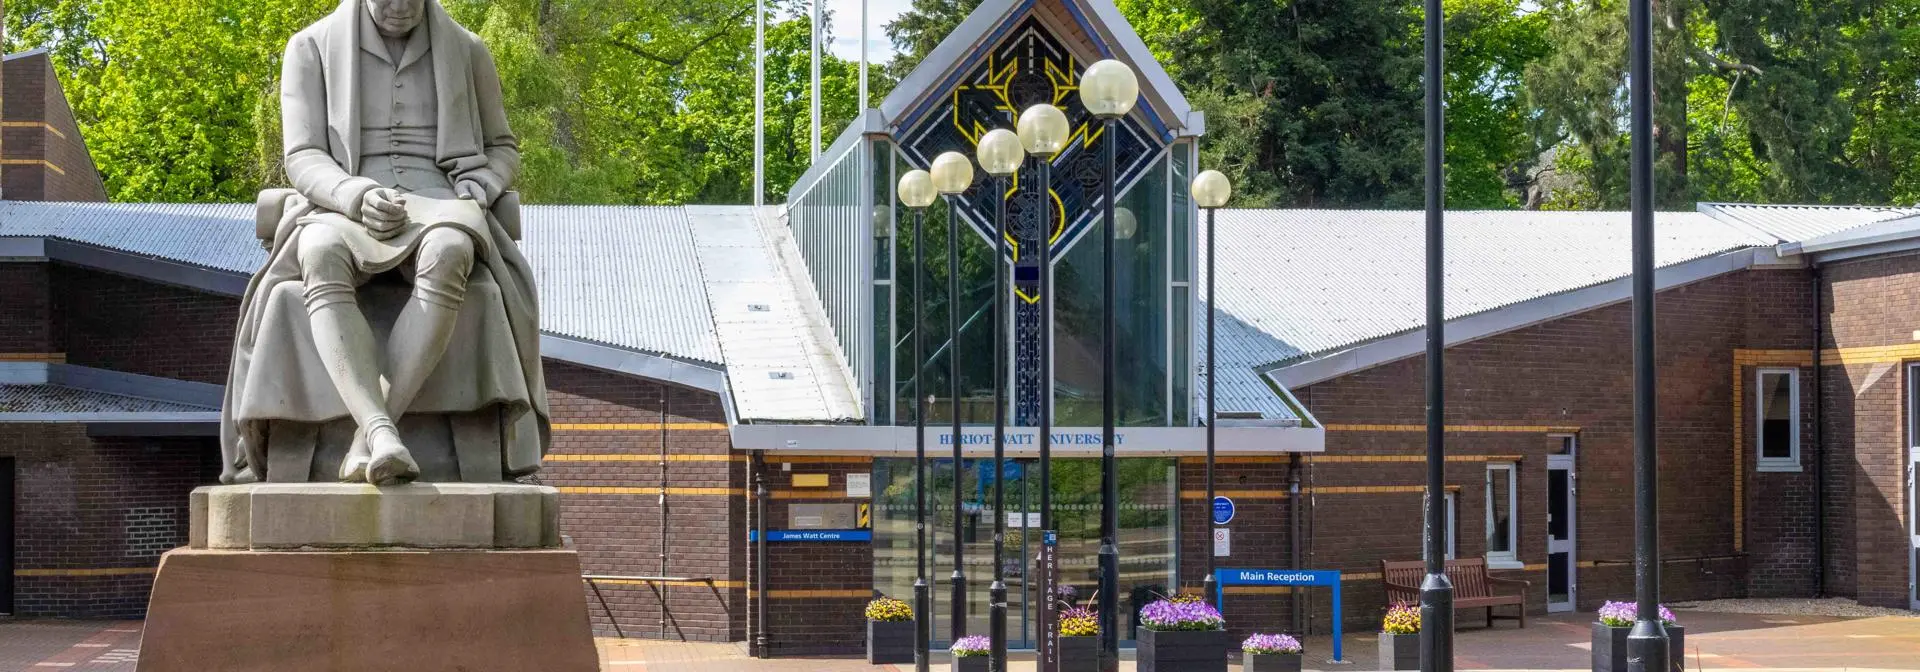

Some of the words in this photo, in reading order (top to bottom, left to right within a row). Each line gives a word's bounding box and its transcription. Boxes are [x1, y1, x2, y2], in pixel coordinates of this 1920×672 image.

[1048, 433, 1125, 445] NIVERSY
[783, 532, 802, 540] James
[802, 532, 818, 540] Watt
[819, 532, 841, 540] Centre
[1240, 571, 1265, 581] Main
[1267, 571, 1315, 583] Reception
